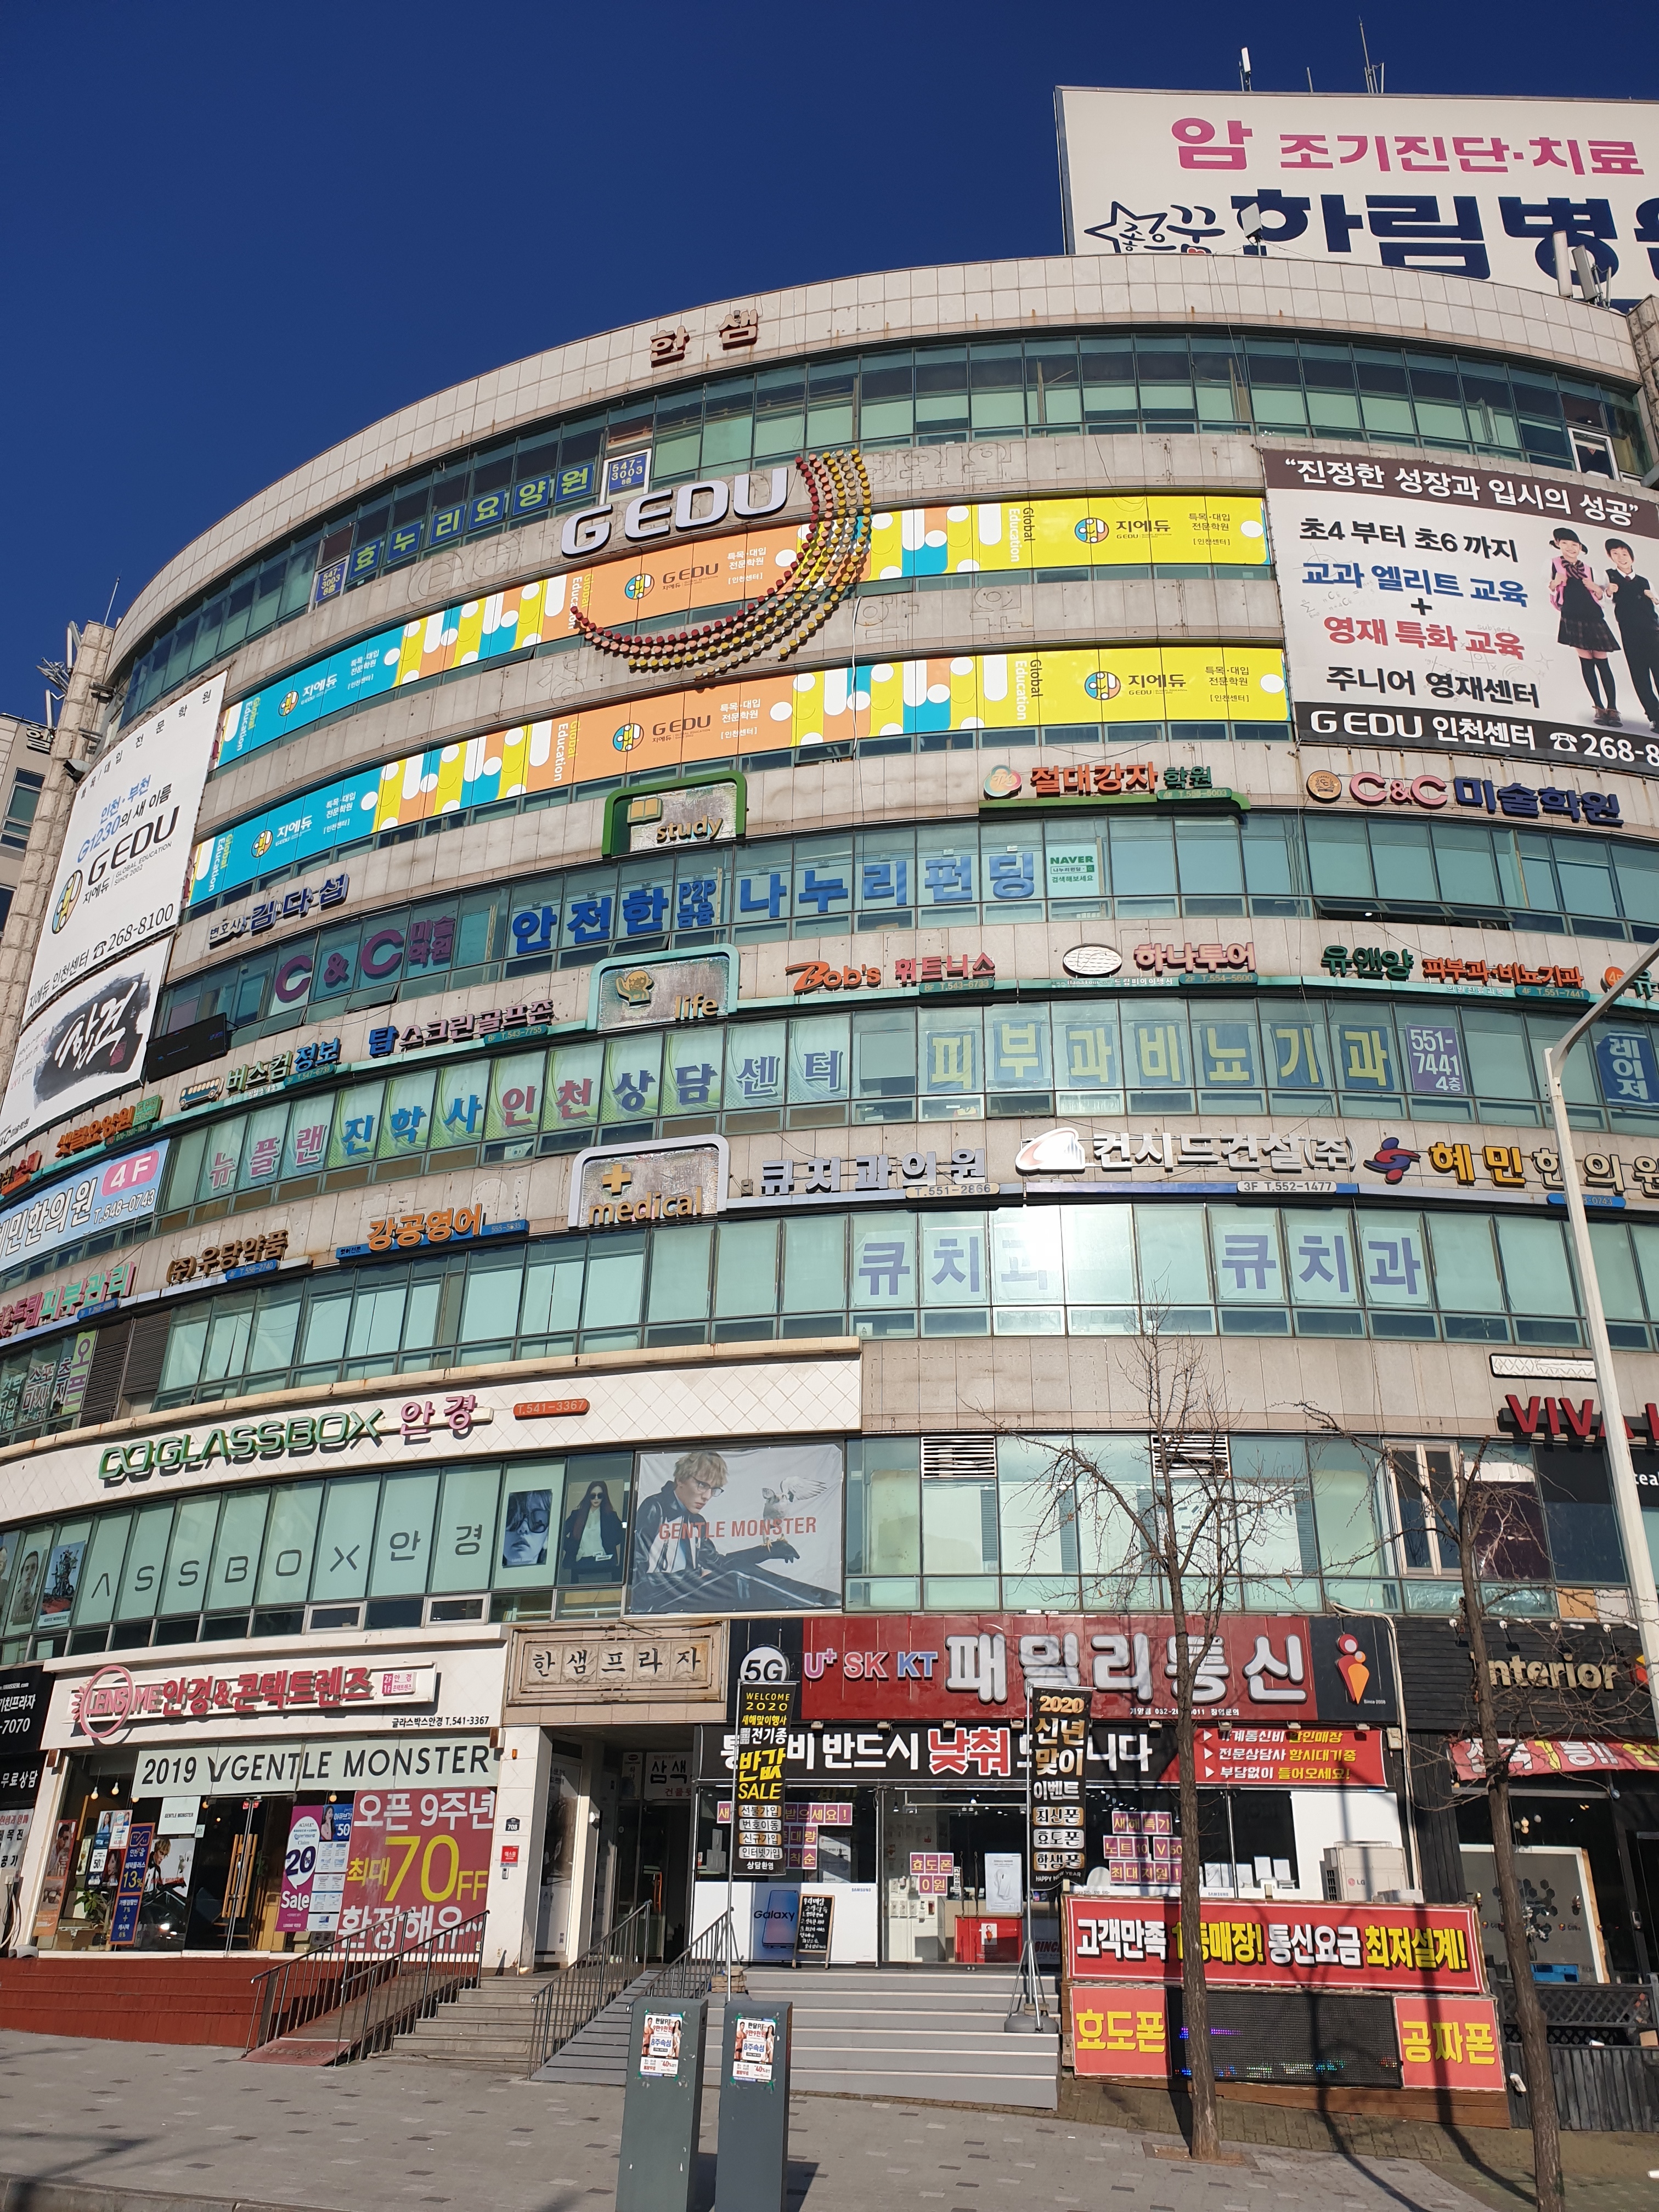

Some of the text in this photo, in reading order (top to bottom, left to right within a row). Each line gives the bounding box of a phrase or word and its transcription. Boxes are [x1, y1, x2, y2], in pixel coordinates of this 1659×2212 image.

[1171, 117, 1645, 175] 암 조기진단·치료
[611, 466, 643, 481] 3003
[1395, 469, 1571, 514] 성장과 입시의
[354, 469, 588, 573] 효누리요양원
[561, 467, 788, 555] GEDU
[1009, 508, 1020, 563] Education
[1022, 507, 1034, 542] Global
[1116, 520, 1171, 533] 지에듀
[1192, 522, 1229, 531] 전문학원
[1299, 518, 1518, 562] 초4 부터 초6 까지
[663, 563, 719, 584] GEDU
[729, 556, 764, 571] 전문학원
[320, 575, 341, 590] 3003
[583, 574, 593, 609] Global
[662, 582, 681, 591] 지에듀
[1302, 563, 1528, 608] 교과 엘리트 교육
[1324, 617, 1525, 660] 영재 특화 교육
[303, 674, 338, 697] 지에듀
[1016, 661, 1026, 720] Education
[1030, 659, 1042, 698] Global
[1128, 674, 1187, 689] 지에듀
[1208, 677, 1248, 686] 전문학원
[1327, 667, 1539, 708] 주니어 영재센터
[236, 701, 253, 751] Education
[652, 715, 711, 736] GEDU
[721, 710, 759, 723] 전문학원
[568, 720, 580, 758] Global
[652, 734, 672, 743] 지에듀
[1311, 710, 1537, 751] GEDU 인천센터
[554, 722, 569, 782] Education
[1031, 761, 1158, 797] 절대강자
[1164, 766, 1212, 788] 학원
[133, 783, 172, 817] 새 이름
[1454, 776, 1624, 828] 미술학원
[276, 815, 313, 838] 지에듀
[656, 815, 723, 843] study
[88, 805, 180, 885] GEDU
[116, 842, 172, 878] GLOBAL EDUCATION
[208, 834, 225, 892] Education
[1050, 855, 1093, 864] NAVER
[83, 877, 110, 904] 지에듀
[679, 879, 716, 902] P2P
[741, 853, 1034, 919] 나누리펀딩
[1051, 875, 1093, 883] 검색해보세요
[210, 873, 350, 945] 변호사 김다섭
[511, 888, 669, 955] 안전한
[677, 902, 714, 928] 금융
[410, 916, 455, 942] 미술
[408, 938, 453, 964] 학원
[1135, 942, 1256, 973] 하나투어
[1322, 945, 1414, 980] 유앤양
[52, 947, 91, 990] 인천센터
[785, 953, 996, 993] Bob's 휘트니스
[1201, 974, 1254, 982] T.554-5600
[675, 992, 718, 1020] life
[1537, 989, 1584, 998] T.551-7441
[501, 1026, 542, 1039] T.543-7755
[1410, 1029, 1453, 1052] 551-
[1413, 1054, 1459, 1076] 7441
[1609, 1038, 1647, 1098] 레이저
[1436, 1076, 1461, 1092] 4층
[110, 1163, 151, 1189] 4F
[761, 1149, 986, 1195] 큐치과의원
[915, 1184, 991, 1197] T.551-2866
[1264, 1183, 1332, 1192] T.552-1477
[94, 1189, 155, 1224] T.548-0743
[589, 1187, 702, 1225] medical
[368, 1204, 483, 1251] 강공영어
[1221, 1235, 1421, 1295] 큐치과
[65, 1339, 91, 1406] 오픈
[400, 1395, 477, 1435] 안경
[516, 1401, 587, 1416] T.541-3367
[659, 1516, 816, 1540] GENTLE MONSTER
[389, 1524, 483, 1562] 안경
[532, 1646, 702, 1677] 한샘프라자
[744, 1657, 783, 1681] 5G
[843, 1632, 1310, 1703] SK KT 패밀리통신
[86, 1687, 161, 1716] LENS ME
[746, 1692, 790, 1701] WELCOME
[746, 1702, 788, 1711] 2020
[1040, 1696, 1084, 1712] 2020
[445, 1715, 490, 1726] T.541-3367
[742, 1714, 787, 1726] 새해맞이행사
[1035, 1718, 1084, 1746] 신년
[752, 1728, 787, 1744] 전기종
[823, 1727, 1011, 1776] 반드시 낮춰
[1036, 1748, 1082, 1776] 맞이
[1219, 1748, 1356, 1762] 전문상담사 항시대기중
[141, 1745, 490, 1786] 2019 MONSTER
[739, 1749, 786, 1782] 반값
[1220, 1767, 1350, 1780] 부담없이 들어오세요!
[1, 1770, 38, 1788] 무료상담
[738, 1783, 783, 1799] SALE
[1034, 1781, 1079, 1799] 이벤트
[354, 1791, 495, 1831] 오픈 9주년
[742, 1806, 778, 1816] 선불가입
[1036, 1808, 1081, 1824] 최신폰
[742, 1819, 778, 1830] 번호이동
[742, 1833, 778, 1844] 신규가입
[1036, 1831, 1081, 1847] 효도폰
[742, 1847, 780, 1859] 인터넷가입
[747, 1861, 774, 1870] 상담환영
[912, 1858, 952, 1872] 효도폰
[1036, 1853, 1081, 1869] 학생폰
[123, 1871, 143, 1888] 13%
[347, 1857, 390, 1886] 최대
[281, 1891, 309, 1911] Sale
[754, 1910, 795, 1921] Galaxy
[1076, 1918, 1468, 1969] 고객만족 통신요금 최저설계!
[1075, 2008, 1166, 2052] 효도폰
[1402, 2020, 1495, 2064] 공짜폰
